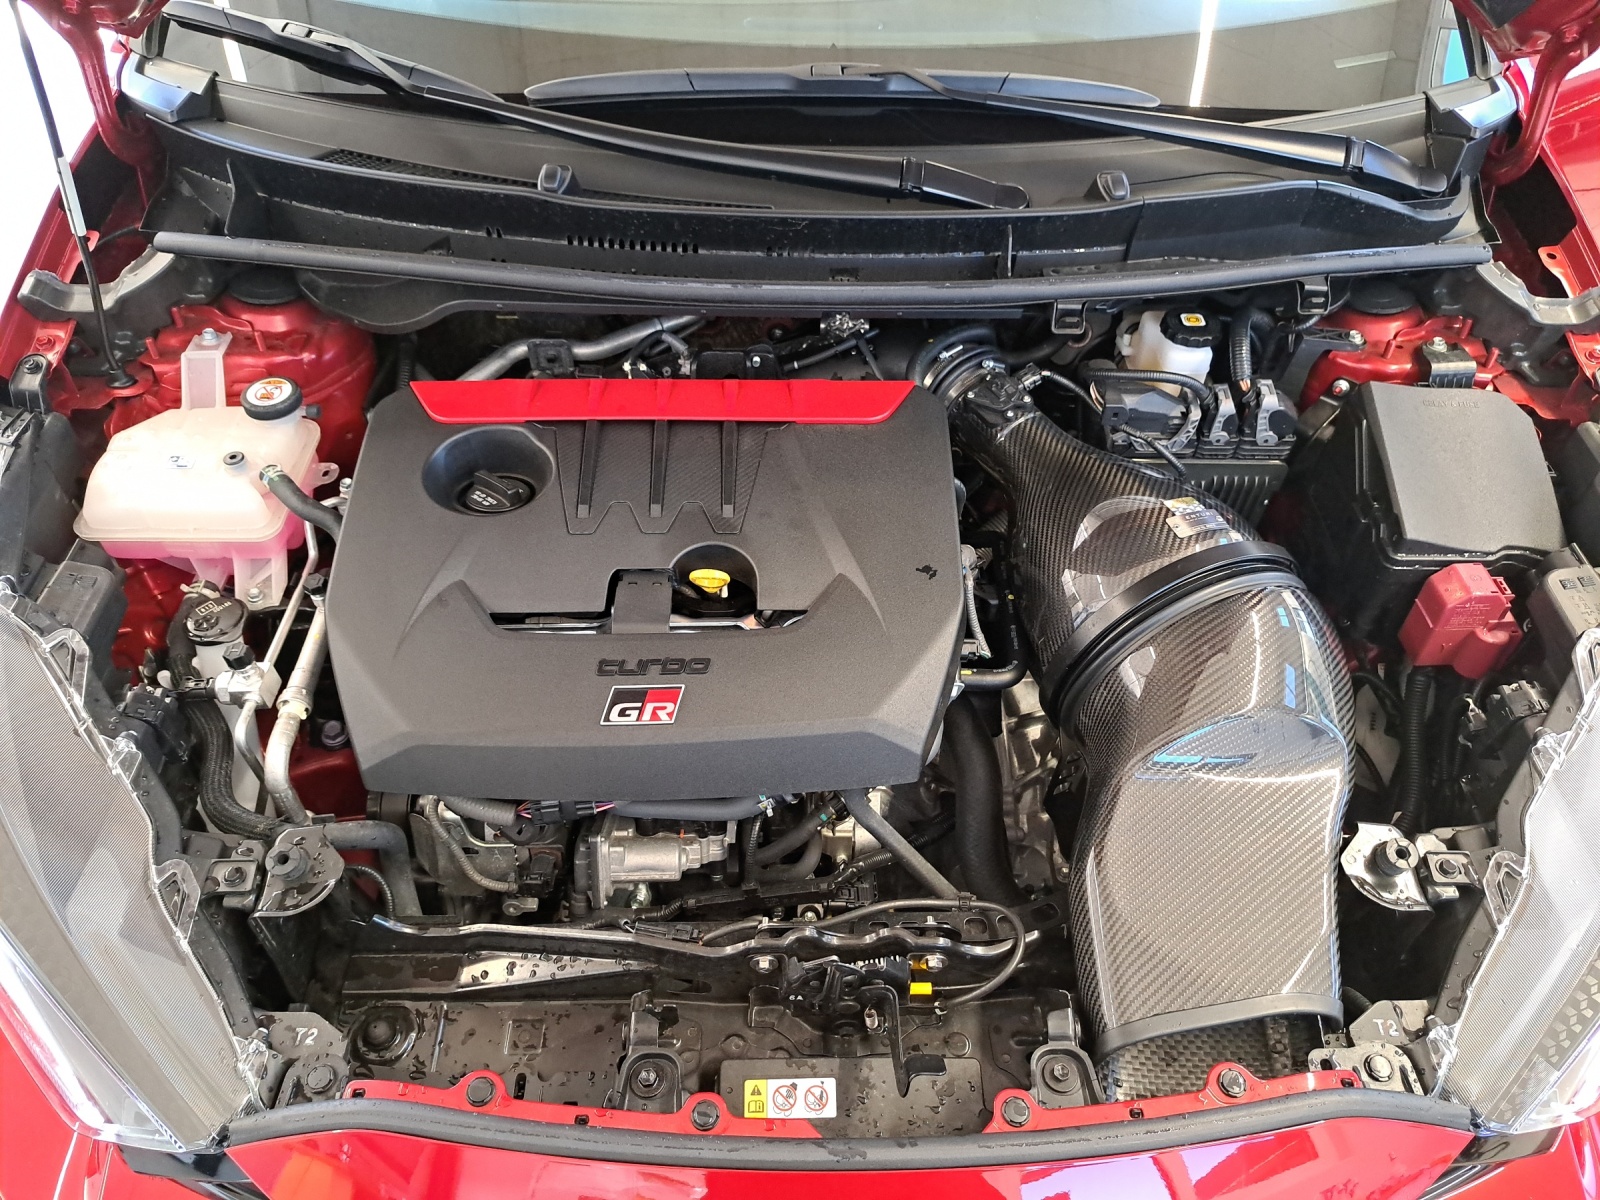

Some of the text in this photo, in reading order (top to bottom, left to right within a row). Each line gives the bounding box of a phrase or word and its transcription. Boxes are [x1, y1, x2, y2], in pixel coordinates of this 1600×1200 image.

[596, 657, 711, 676] turbo
[608, 702, 676, 722] GR
[1372, 1018, 1399, 1037] T2
